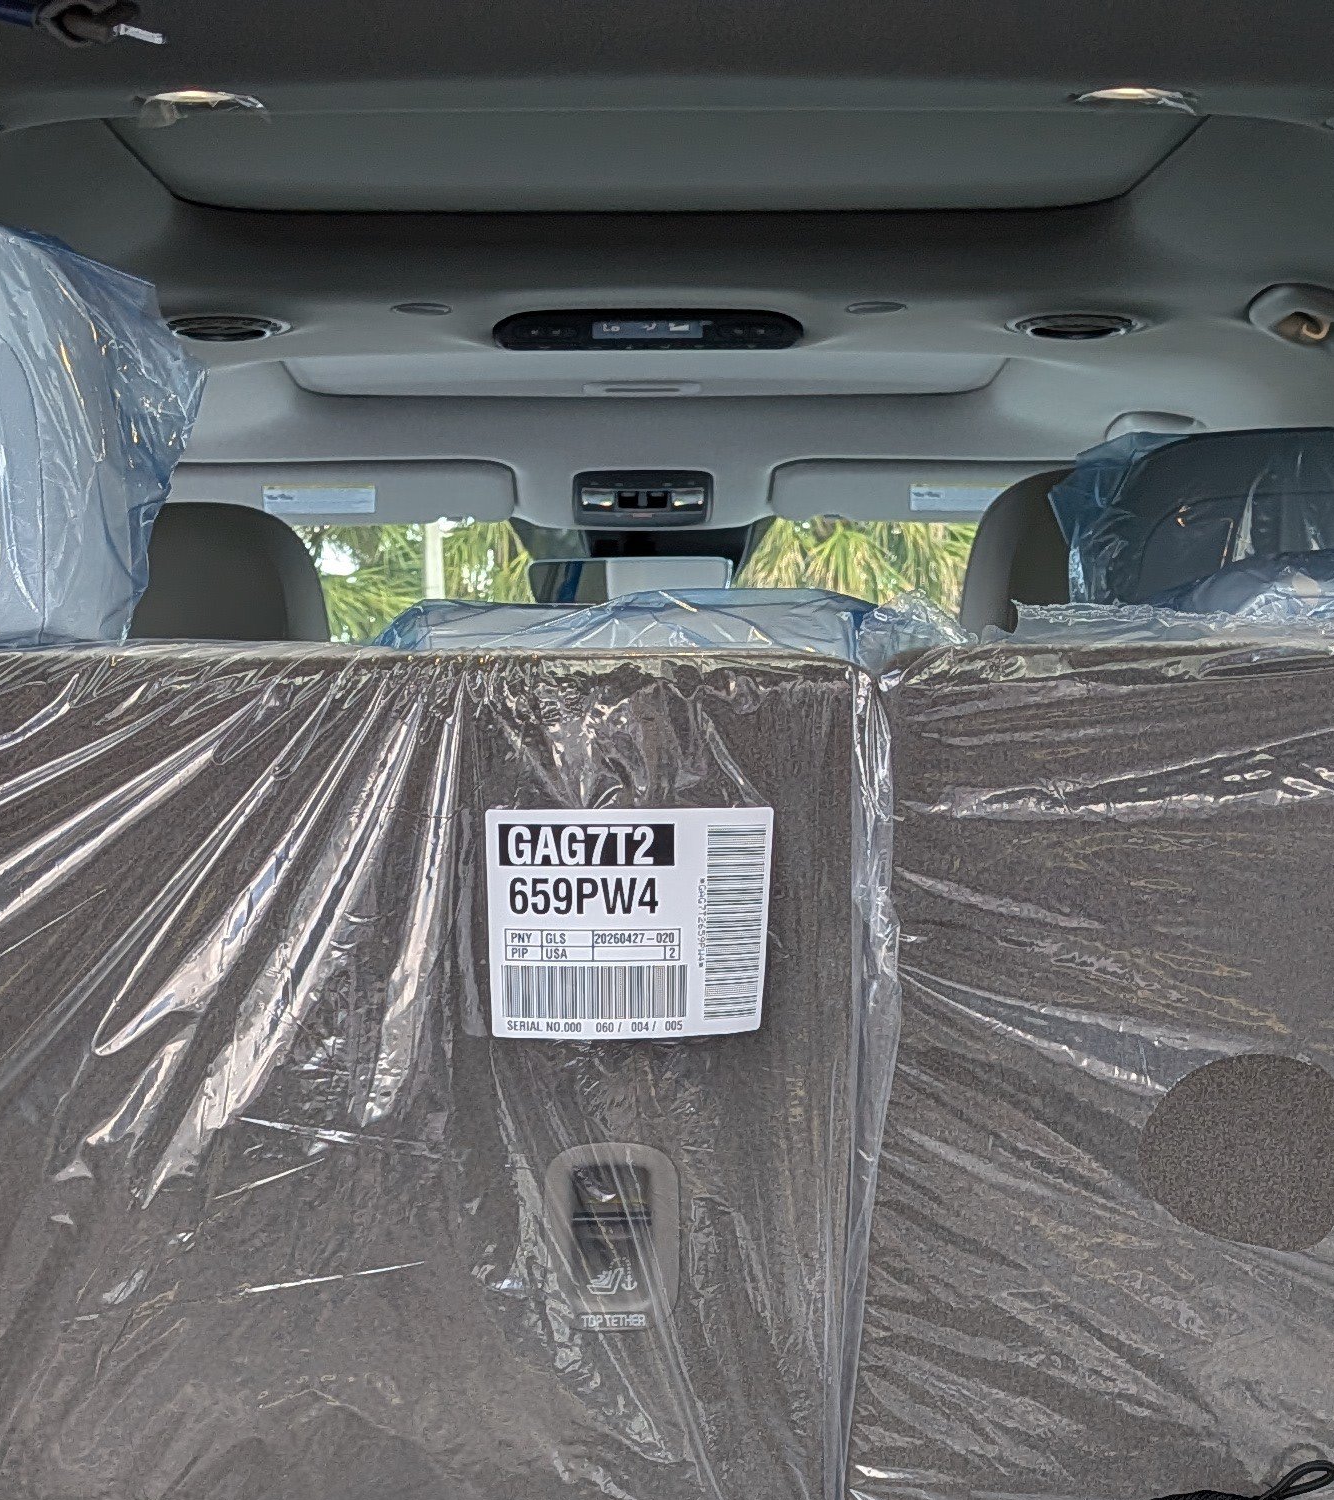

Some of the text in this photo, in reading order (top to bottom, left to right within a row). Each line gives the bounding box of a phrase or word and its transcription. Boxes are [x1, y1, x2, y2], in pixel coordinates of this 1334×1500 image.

[507, 825, 655, 866] GAG7T2
[508, 877, 659, 915] 659PW4
[510, 932, 532, 944] PNY
[545, 932, 567, 944] GLS
[511, 947, 676, 959] PIP USA 2
[506, 1020, 543, 1032] SERIAL
[581, 1313, 646, 1327] TOP TETHER
